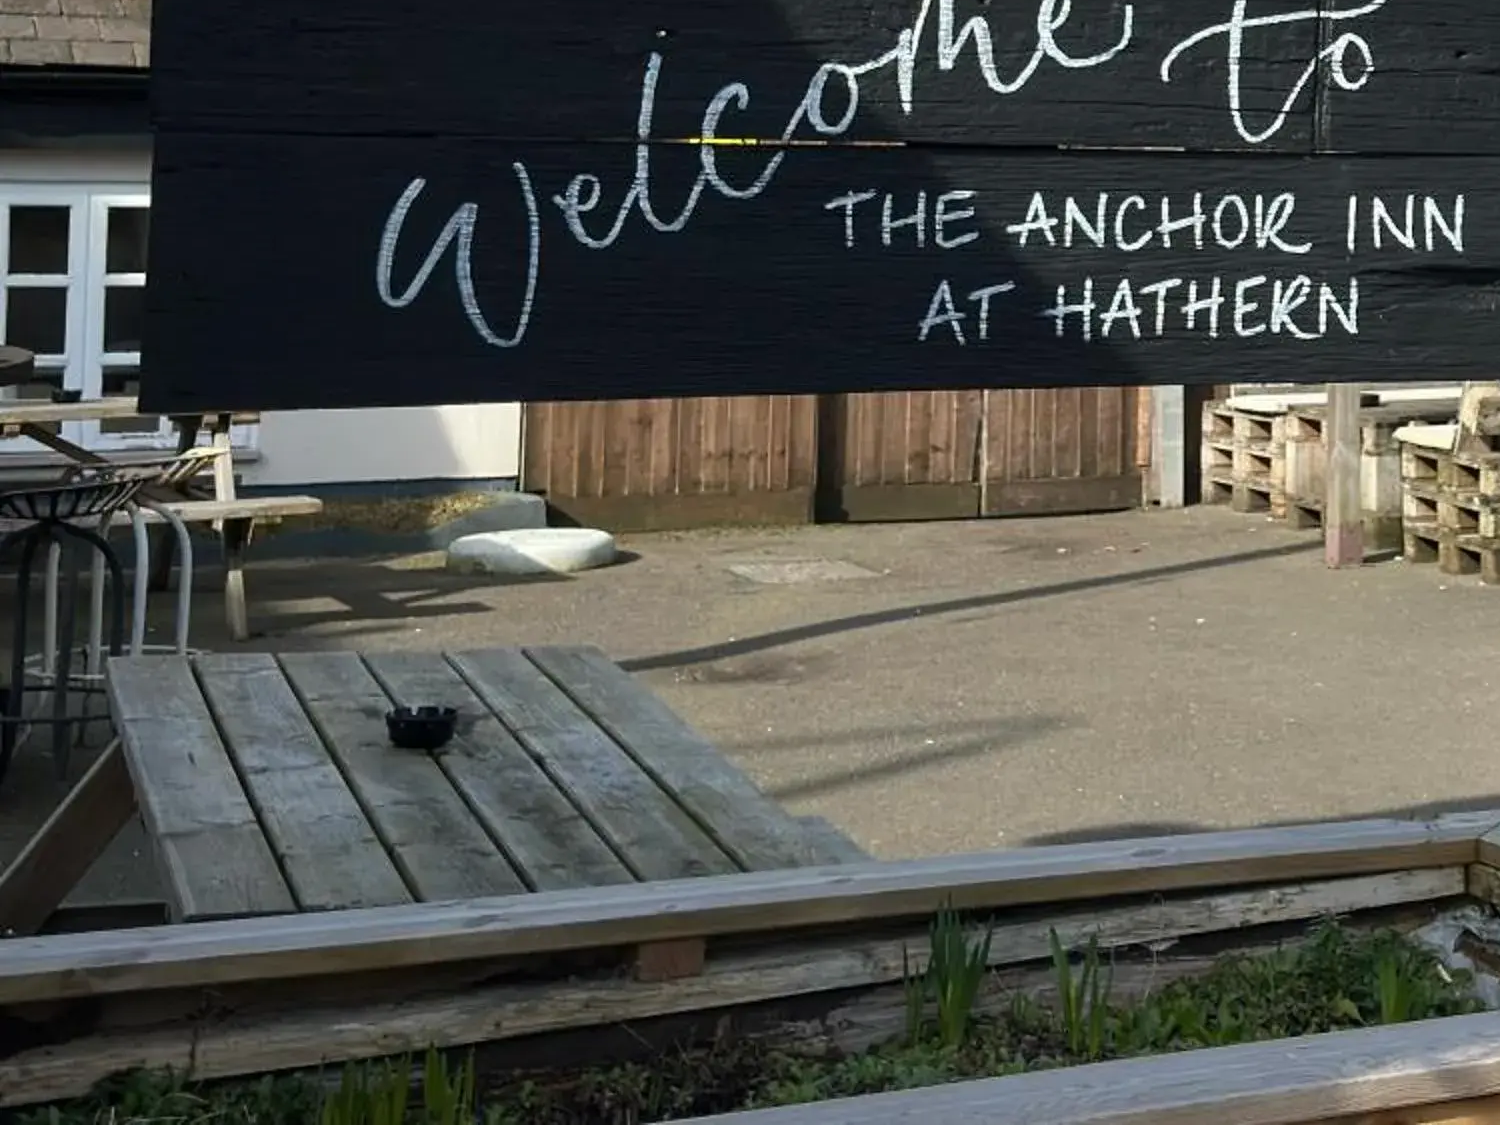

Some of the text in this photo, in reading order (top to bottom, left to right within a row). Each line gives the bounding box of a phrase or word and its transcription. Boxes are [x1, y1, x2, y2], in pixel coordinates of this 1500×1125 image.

[824, 188, 1465, 254] THE ANCHOR INN
[918, 274, 1360, 345] AT HATHERN
